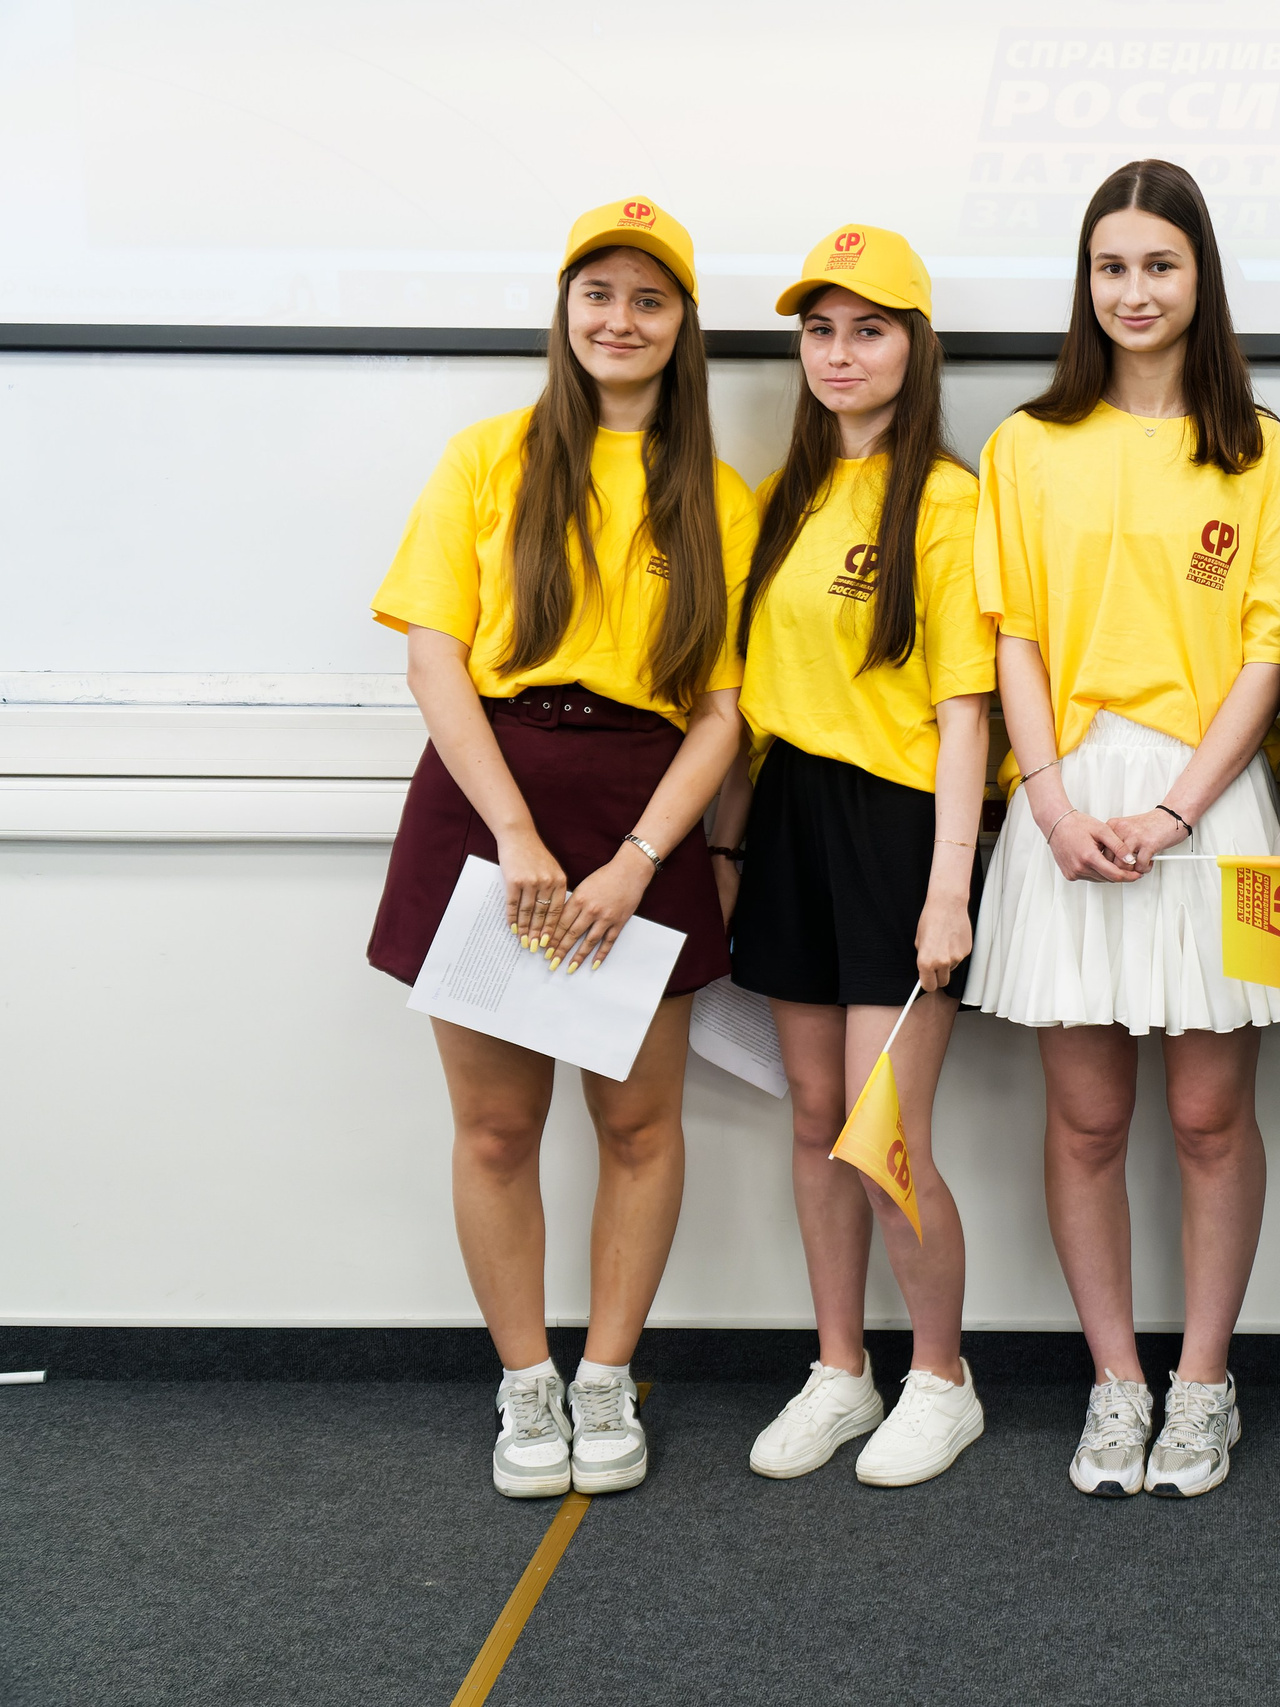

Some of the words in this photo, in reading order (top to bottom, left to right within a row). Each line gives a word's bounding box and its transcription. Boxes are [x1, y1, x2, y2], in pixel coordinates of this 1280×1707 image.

[623, 202, 651, 219] СР
[969, 198, 1040, 229] ЗА
[835, 232, 860, 252] СР
[1201, 520, 1234, 557] СР
[1192, 559, 1228, 576] РОССИЯ
[1254, 873, 1263, 927] РОССИЯ
